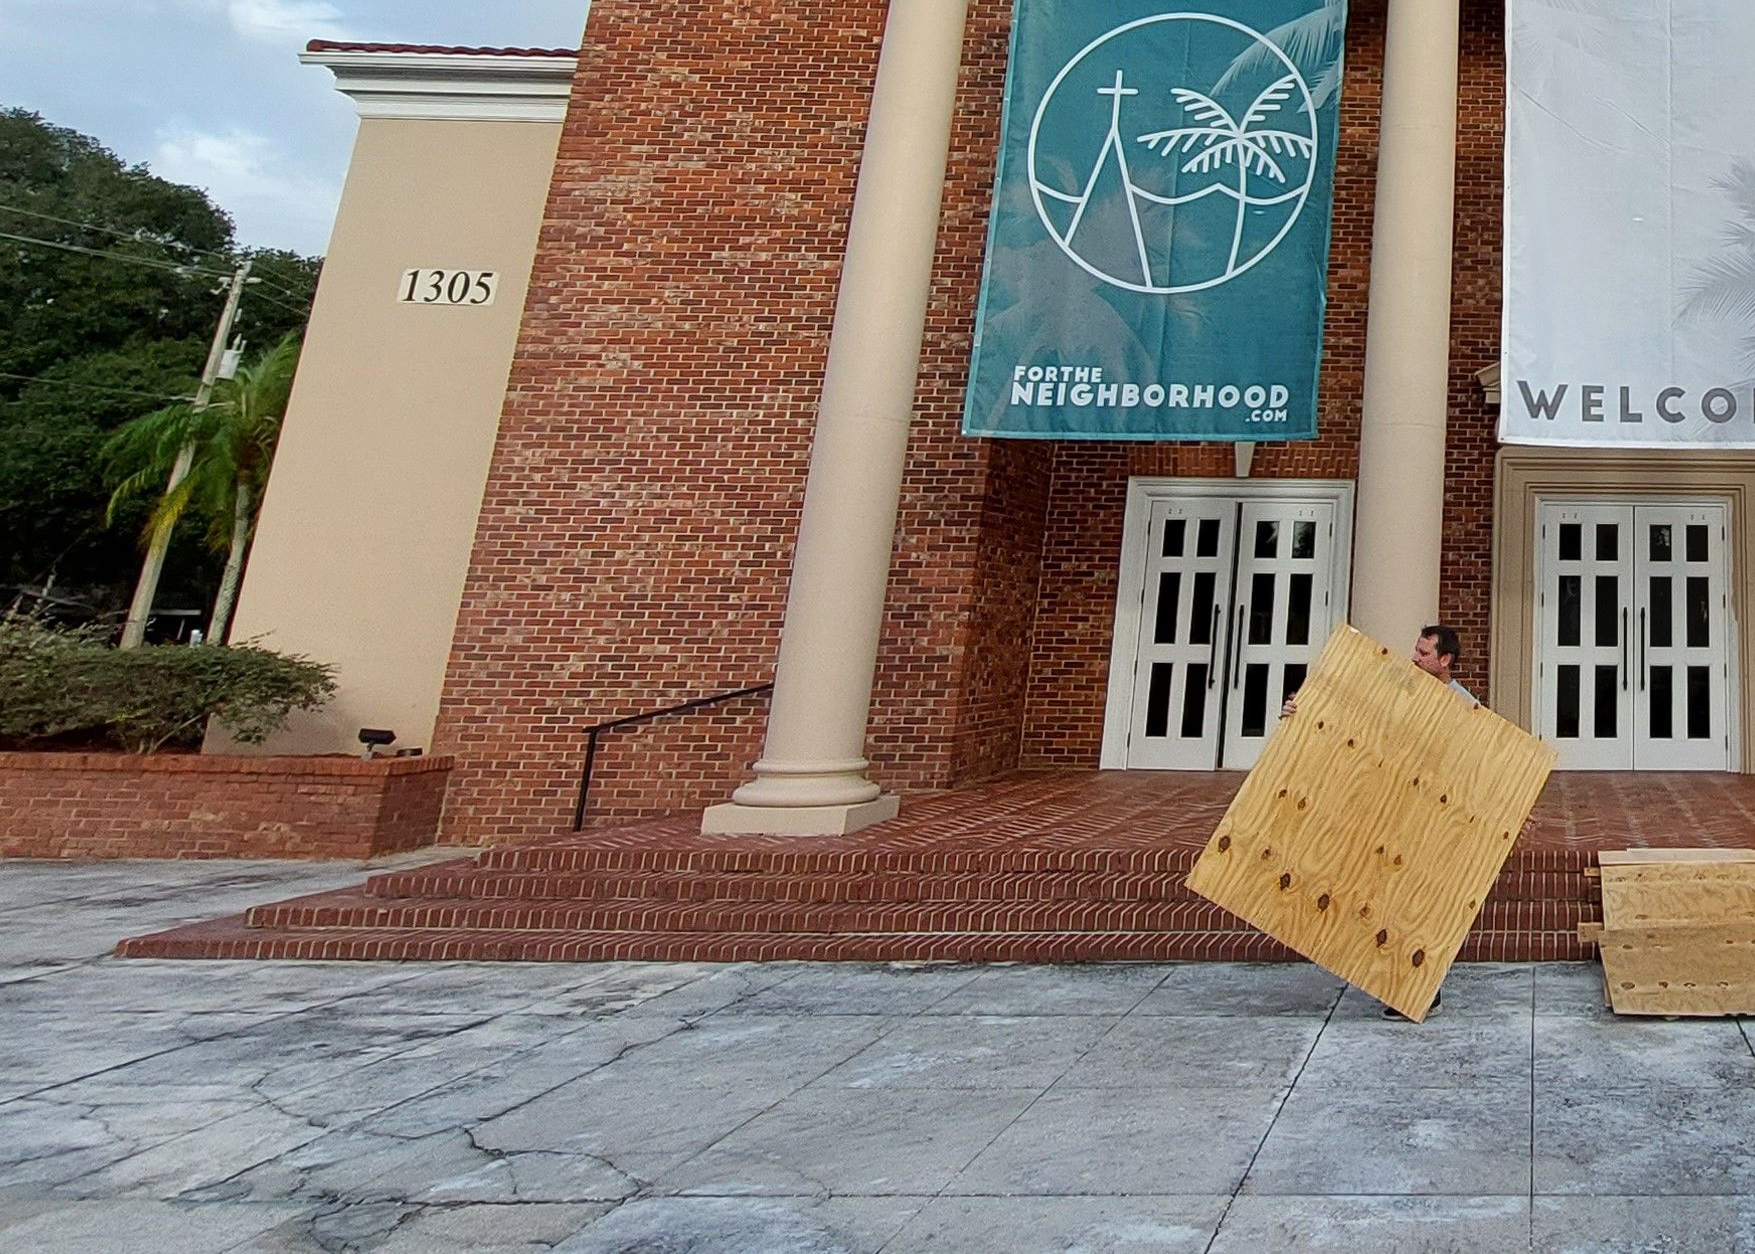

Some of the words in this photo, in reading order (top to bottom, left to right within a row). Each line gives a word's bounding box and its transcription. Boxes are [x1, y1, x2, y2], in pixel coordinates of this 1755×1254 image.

[402, 269, 494, 304] 1305
[1010, 381, 1290, 409] NEIGHBORHOOD
[1245, 408, 1287, 423] .COM
